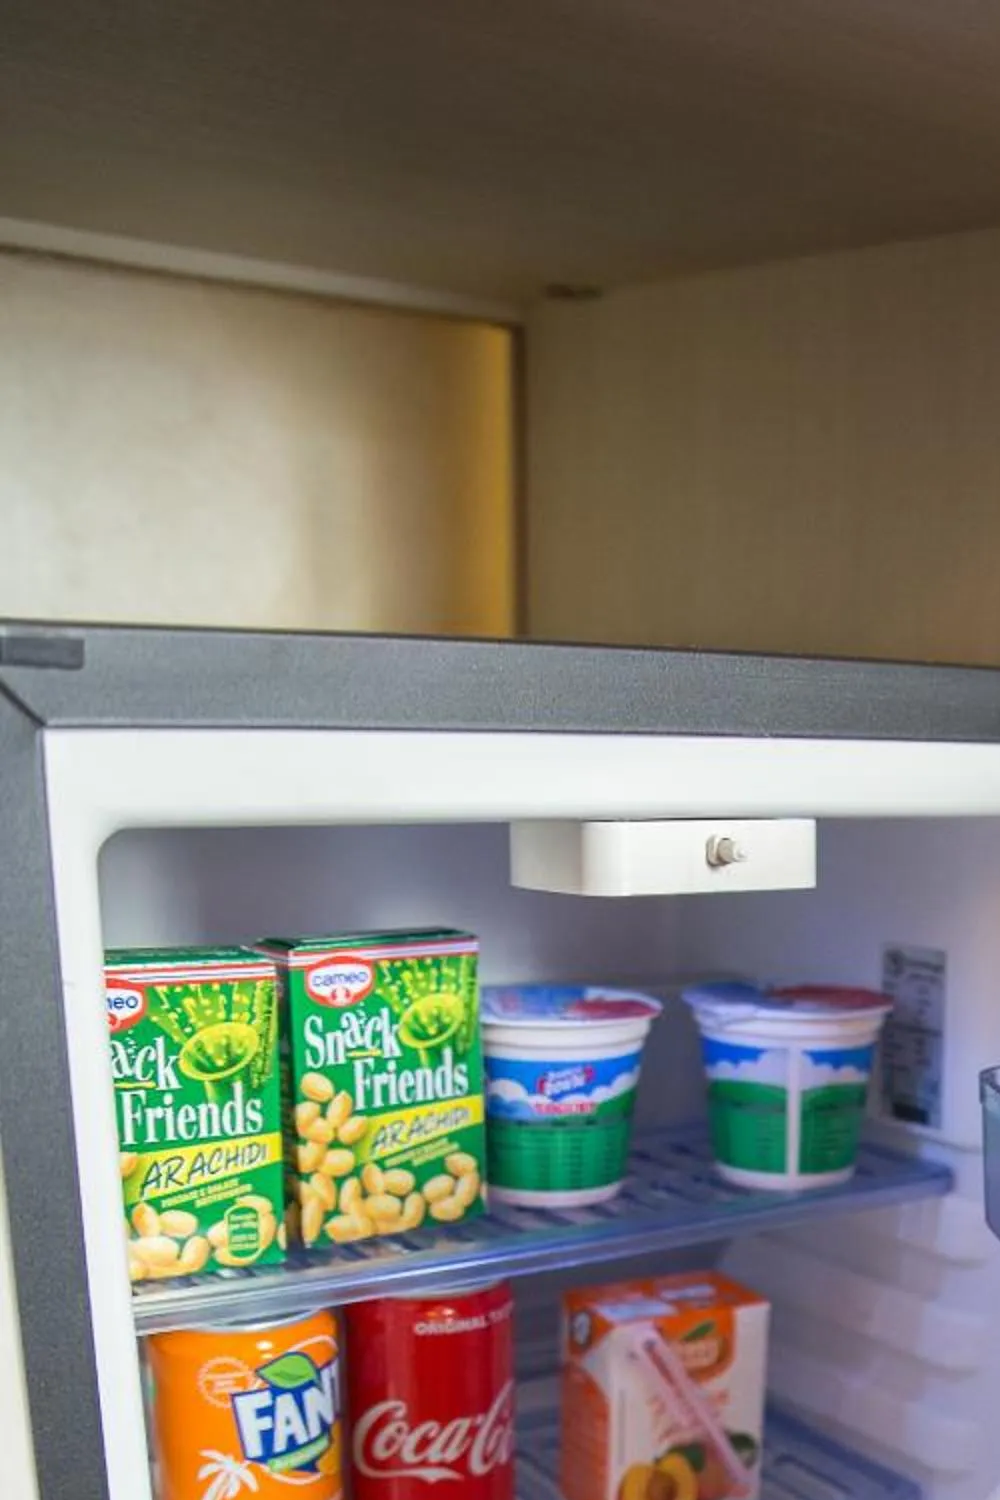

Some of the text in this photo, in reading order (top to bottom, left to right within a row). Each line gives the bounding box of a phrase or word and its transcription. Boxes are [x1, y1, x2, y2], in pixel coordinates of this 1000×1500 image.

[312, 971, 369, 987] cameo
[111, 1035, 183, 1091] ack
[303, 1007, 402, 1069] Snack
[352, 1047, 470, 1111] Friends
[120, 1080, 264, 1146] Friends
[139, 1141, 268, 1198] ARACHIDI
